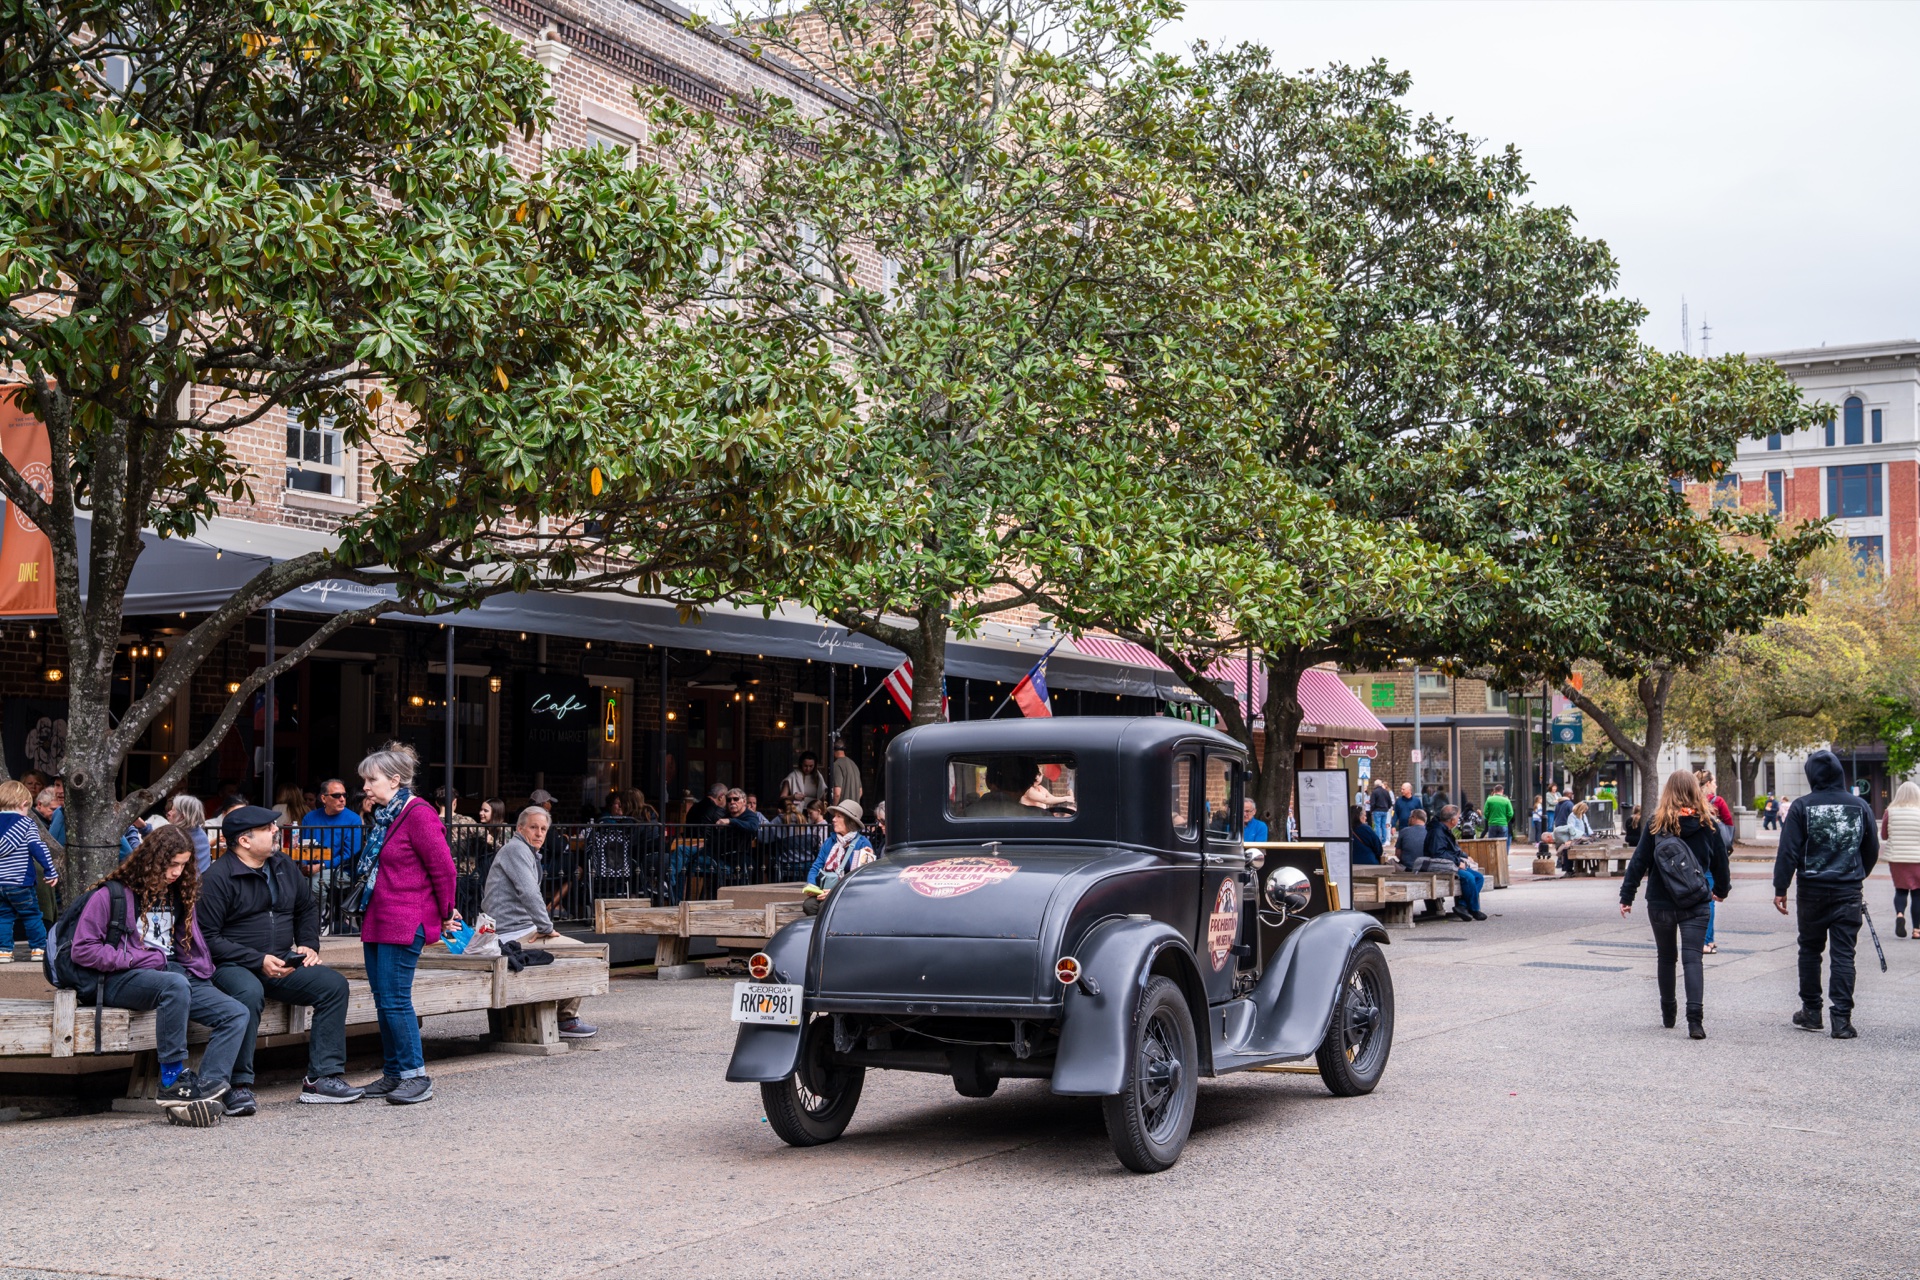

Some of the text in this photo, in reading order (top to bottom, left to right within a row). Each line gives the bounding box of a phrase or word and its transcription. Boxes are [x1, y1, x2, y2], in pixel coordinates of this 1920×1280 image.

[18, 562, 39, 582] DINE
[354, 585, 365, 594] CITY
[365, 586, 386, 596] MARKET
[818, 629, 841, 655] Cafe
[531, 693, 587, 720] Cafe
[558, 729, 587, 742] MARKET
[906, 864, 1015, 874] PROHIBITION
[921, 873, 985, 881] MUSEUM
[751, 985, 787, 994] GEORGIA
[740, 993, 794, 1014] RKP7981
